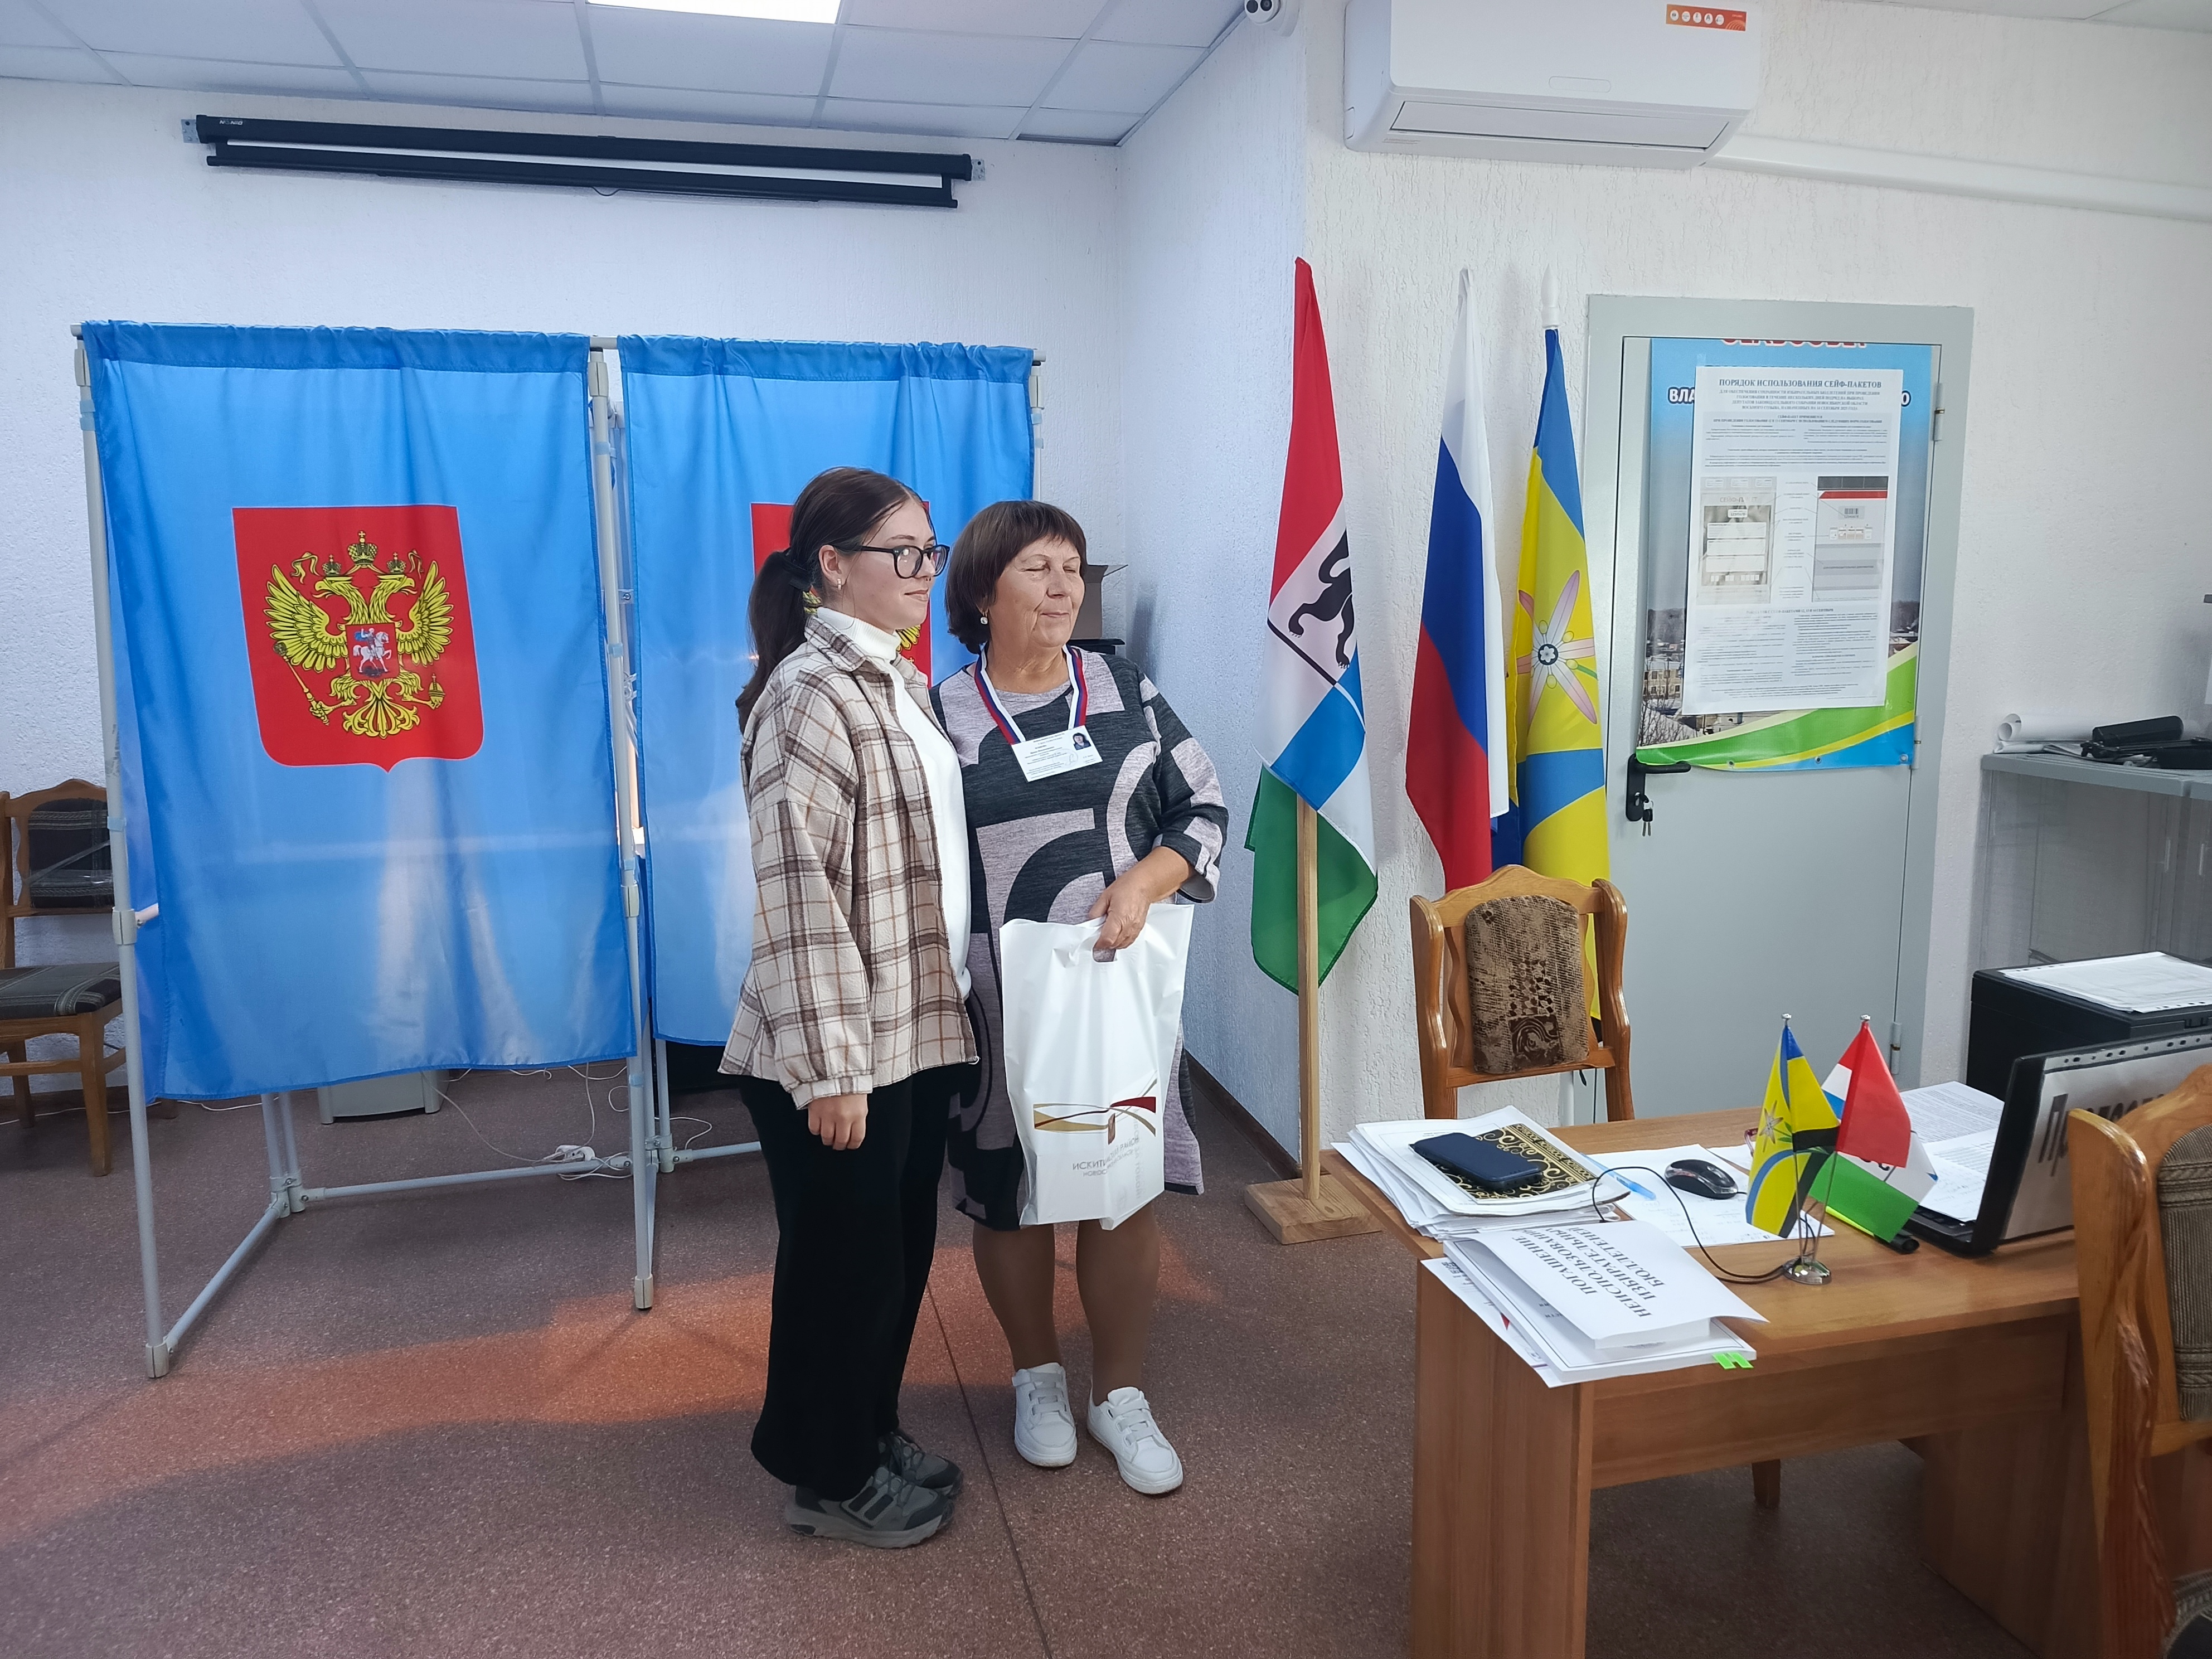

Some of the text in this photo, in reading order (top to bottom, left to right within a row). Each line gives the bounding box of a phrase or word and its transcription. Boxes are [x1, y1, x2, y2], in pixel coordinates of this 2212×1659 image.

[1668, 387, 1695, 403] ВЛА
[1824, 380, 1882, 388] СЕЙФ-ПАКЕТОВ
[1511, 1235, 1598, 1294] ПОГАШЕНИЕ
[1568, 1227, 1666, 1287] БЮЛЛЕТЕНЕЙ
